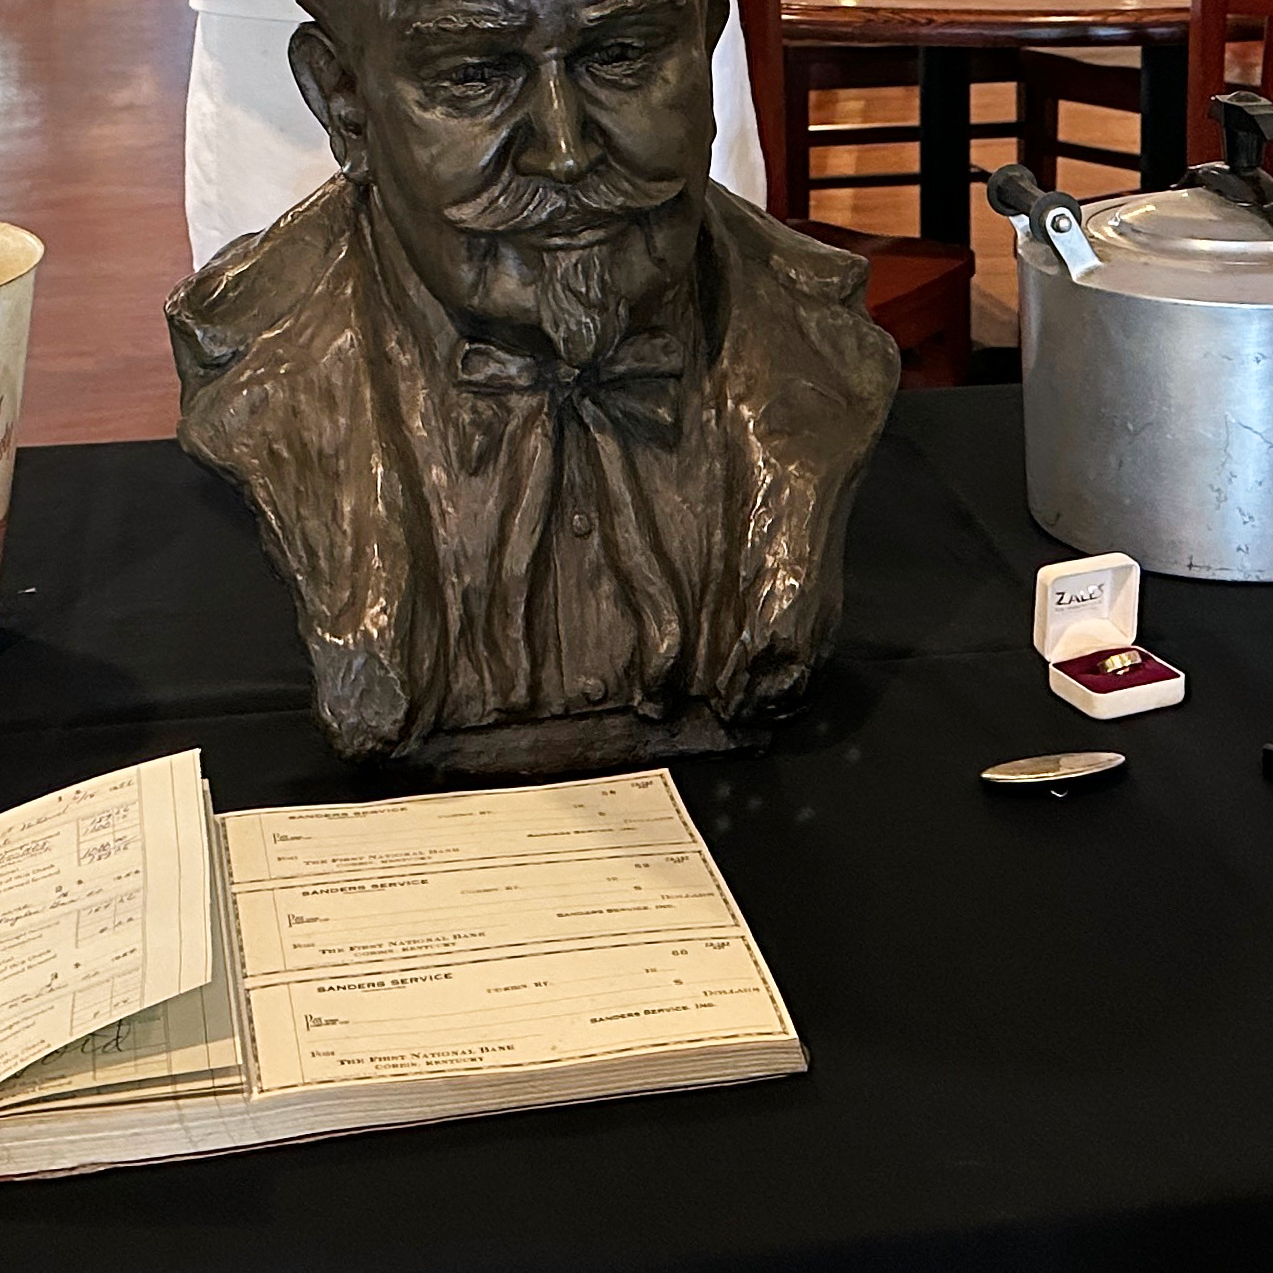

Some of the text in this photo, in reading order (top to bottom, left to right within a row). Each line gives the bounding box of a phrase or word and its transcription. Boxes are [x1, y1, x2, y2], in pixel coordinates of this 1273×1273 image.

[288, 807, 408, 820] SANDERS SERVICE
[301, 878, 429, 897] SANDERS SERVICE
[318, 931, 486, 955] THE FIRST NATIONAL BANK
[316, 972, 453, 993] SANDERS SERVICE
[589, 1011, 641, 1024] SANDERS
[337, 1044, 516, 1066] THE FIRST NATIONAL BANK
